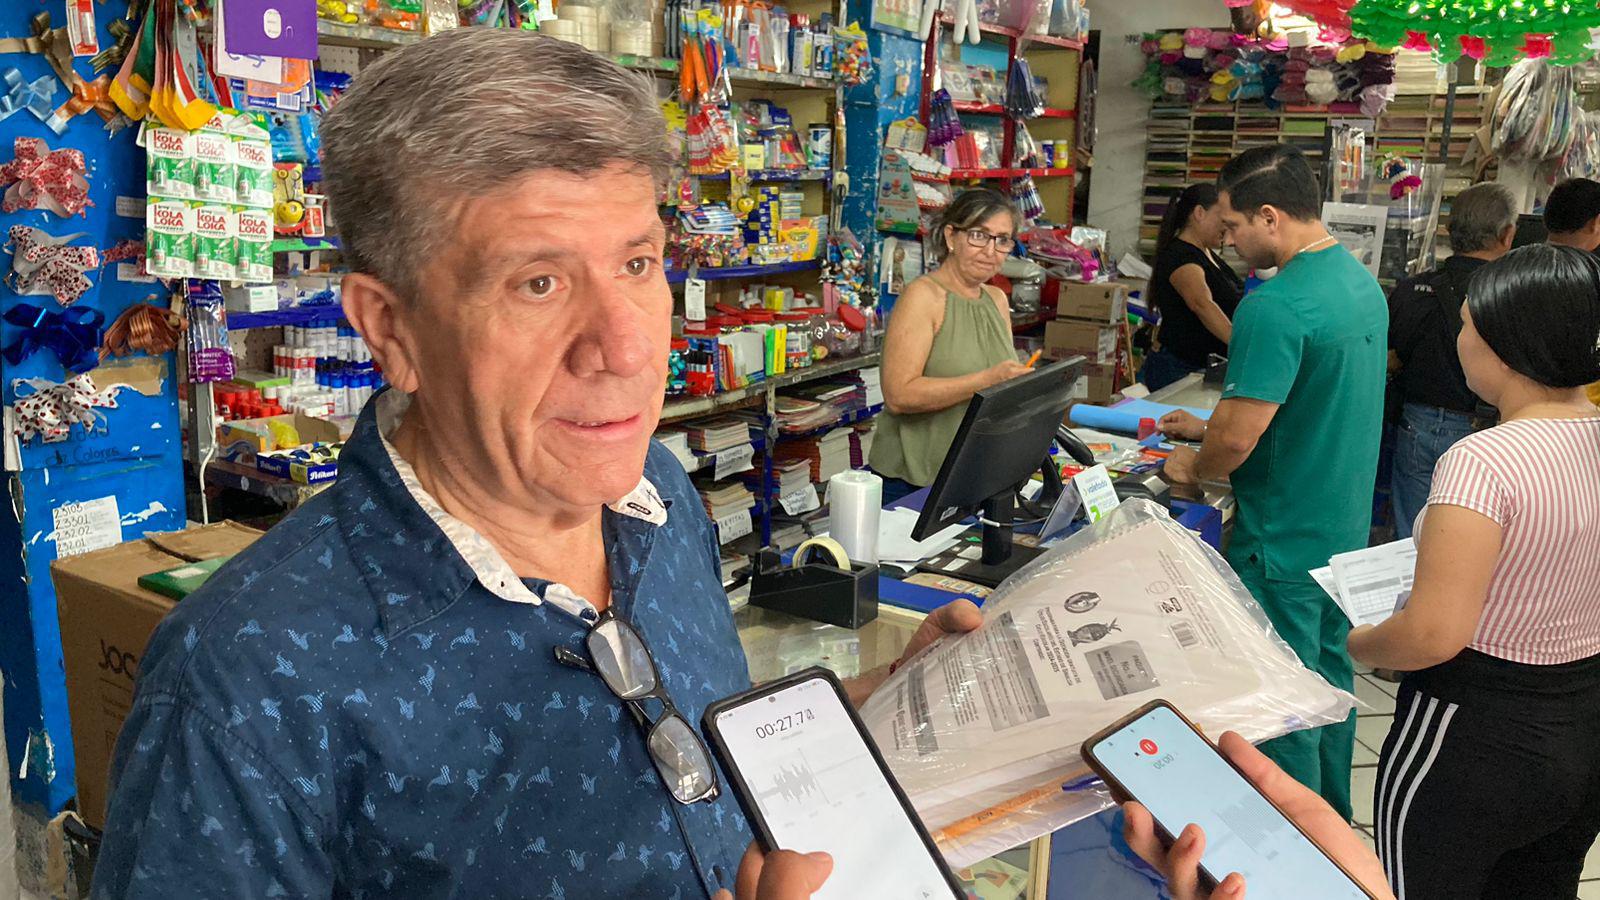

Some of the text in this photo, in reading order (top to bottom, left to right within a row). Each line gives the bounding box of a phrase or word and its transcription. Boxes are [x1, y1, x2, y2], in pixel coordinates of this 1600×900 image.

[153, 129, 183, 145] KOLA
[153, 141, 183, 151] LOKA
[197, 136, 225, 150] KOLA
[197, 147, 225, 156] LOKA
[154, 204, 183, 220] KOLA
[197, 209, 225, 223] KOLA
[153, 218, 183, 227] LOKA
[239, 213, 267, 227] KOLA
[197, 221, 225, 231] LOKA
[239, 224, 267, 235] LOKA
[309, 470, 334, 481] Pelikan
